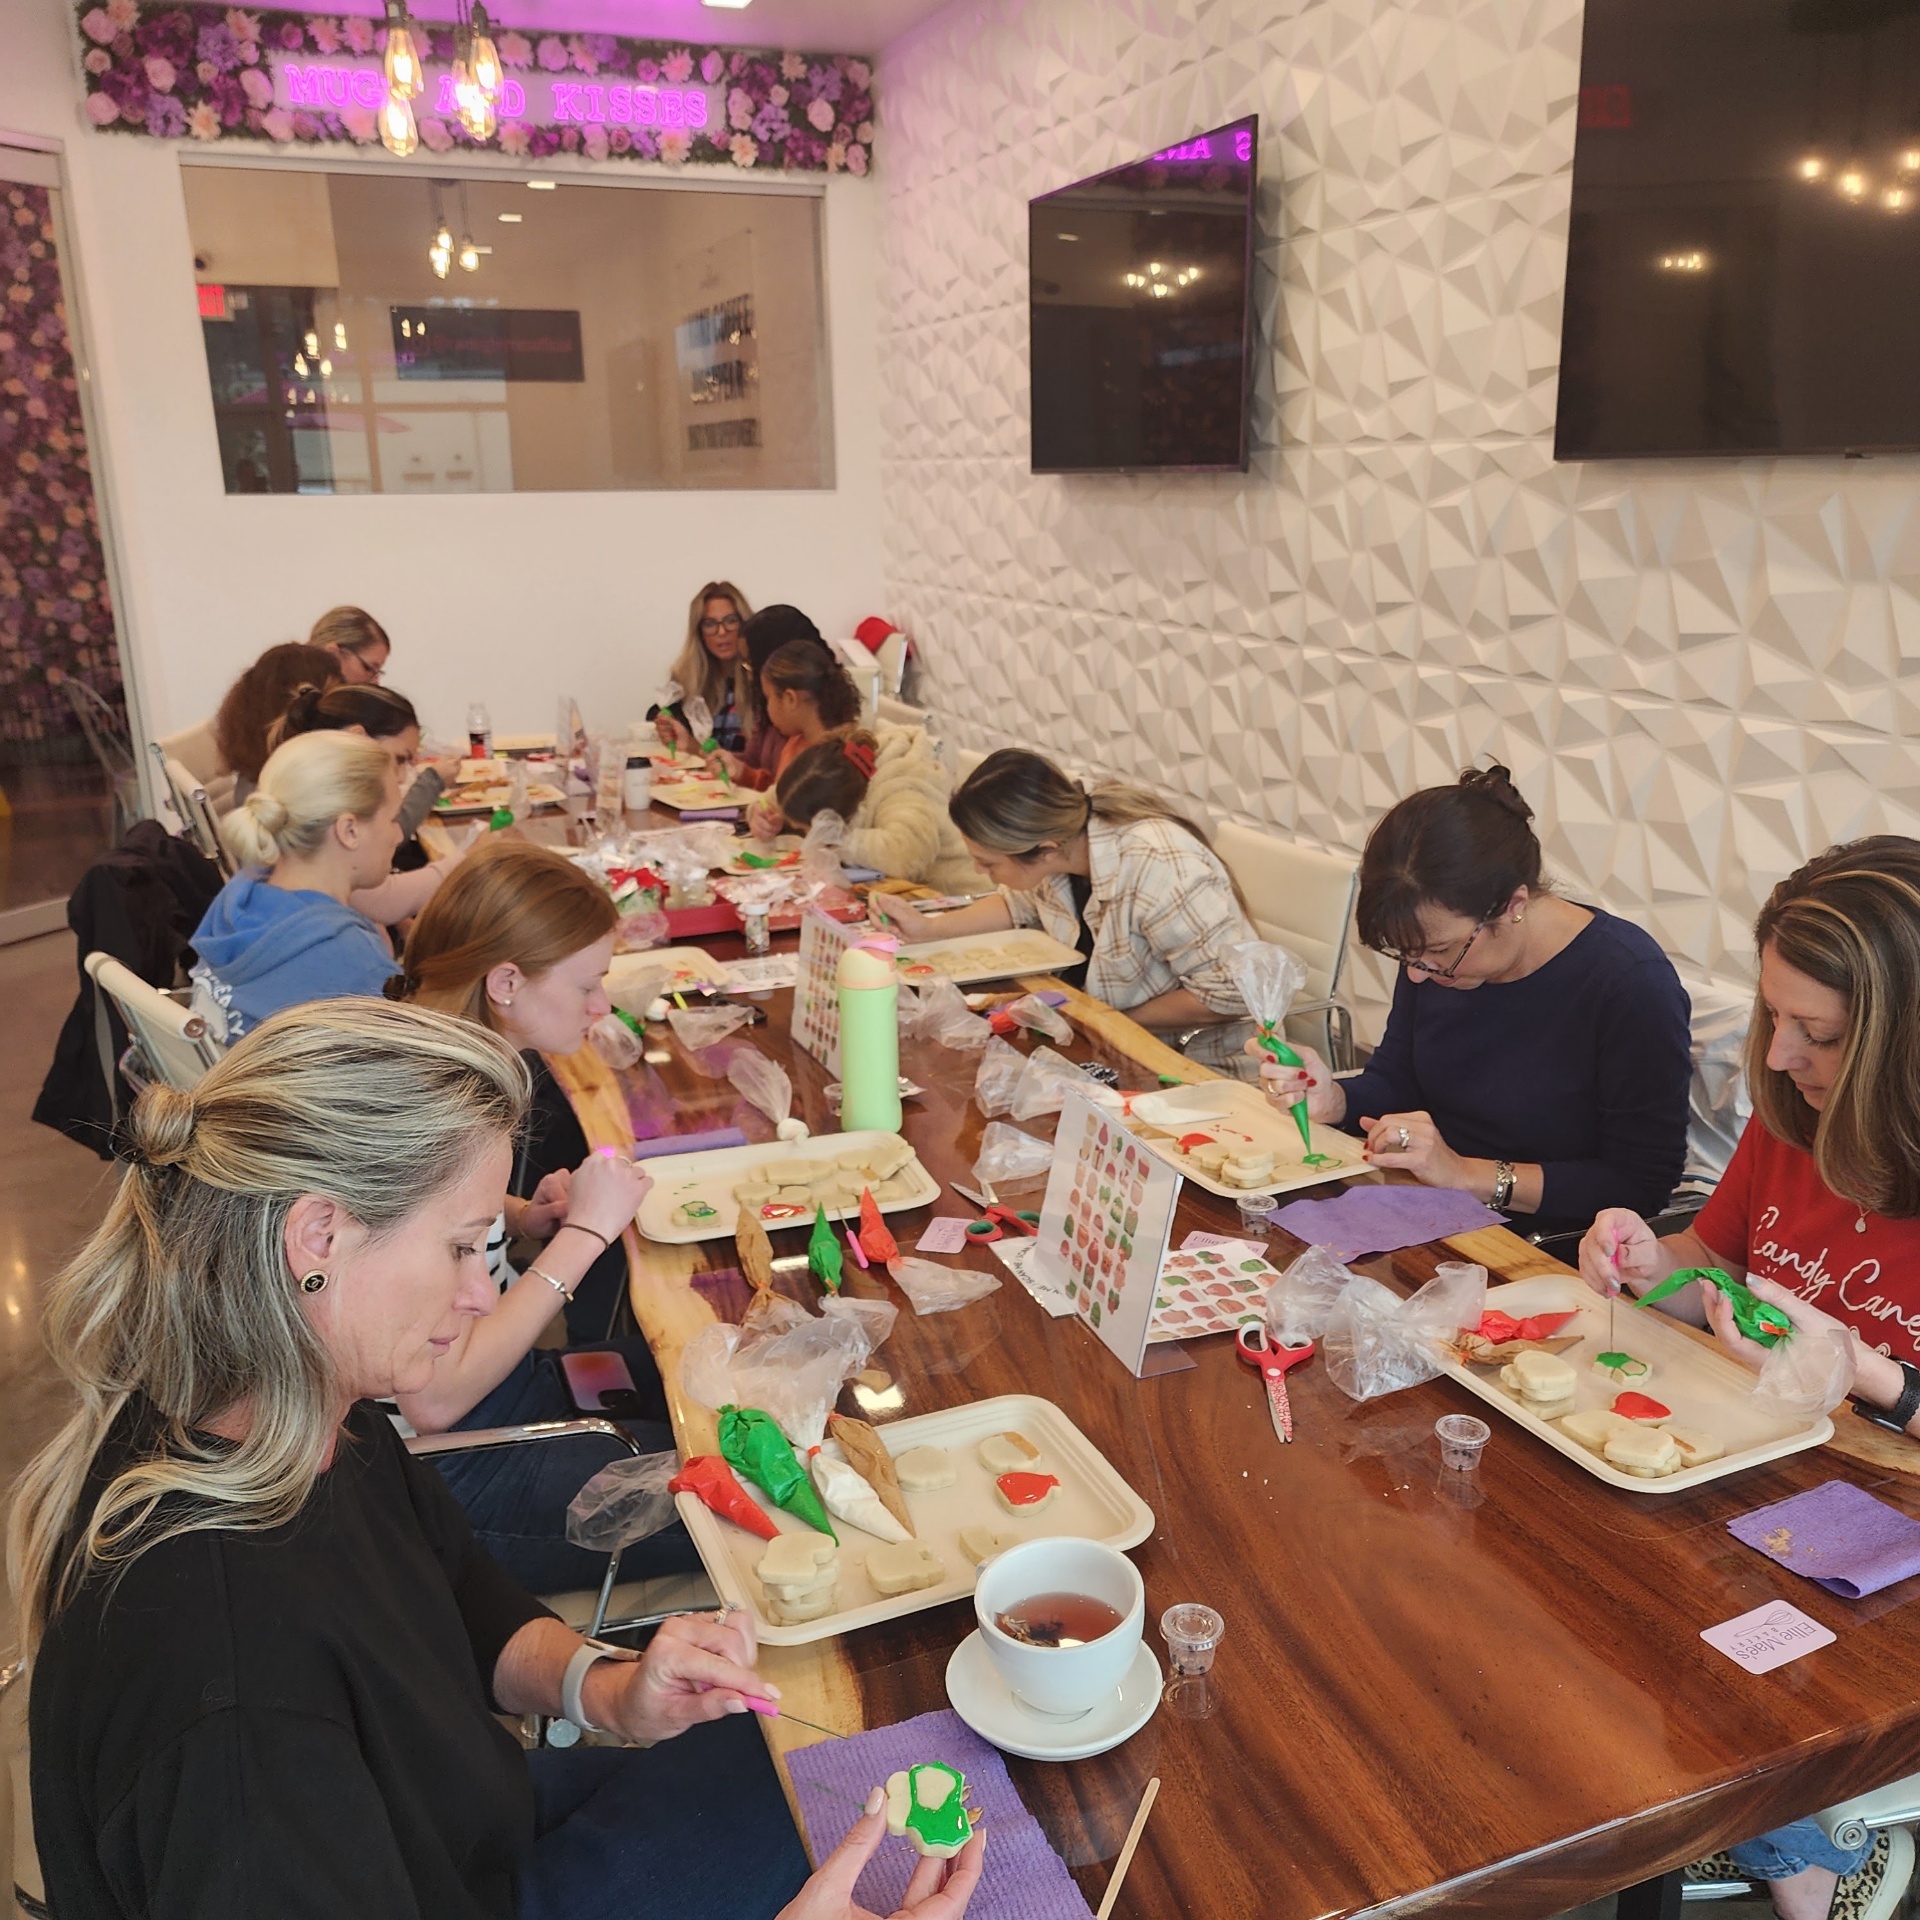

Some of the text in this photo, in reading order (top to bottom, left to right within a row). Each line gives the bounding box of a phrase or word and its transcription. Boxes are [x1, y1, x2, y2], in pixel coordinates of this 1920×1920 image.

[284, 64, 708, 128] MUG AD KISSES
[1753, 1206, 1836, 1304] Candy
[1730, 1627, 1779, 1651] BAKERY
[1736, 1622, 1817, 1660] Ellie Mae's
